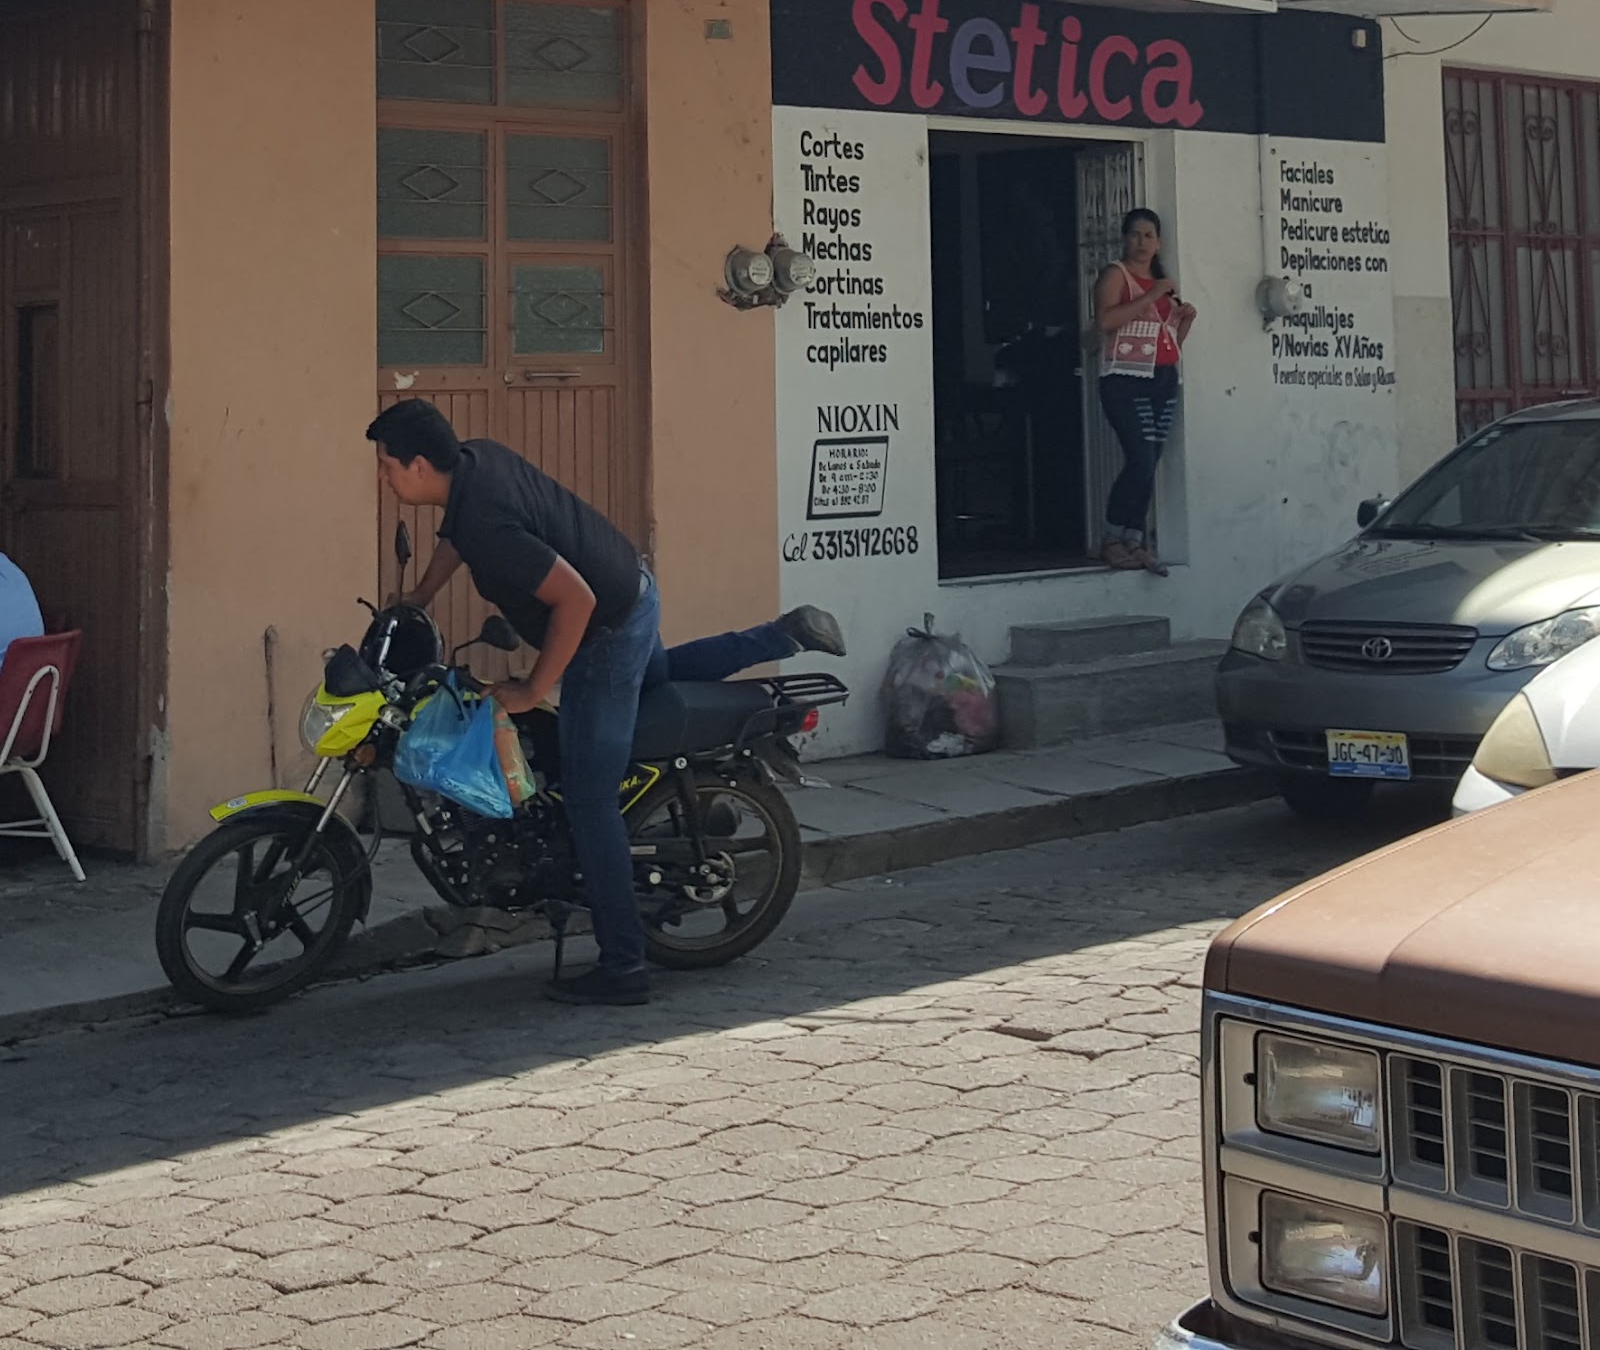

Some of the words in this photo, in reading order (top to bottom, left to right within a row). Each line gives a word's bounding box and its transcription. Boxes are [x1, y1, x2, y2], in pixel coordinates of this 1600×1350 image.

[800, 130, 864, 160] Cortes
[800, 163, 861, 193] Tintes
[1280, 160, 1334, 185] Faciales
[1280, 188, 1343, 213] Manicure
[803, 198, 862, 233] Rayos
[1280, 217, 1338, 243] Pedicure
[802, 232, 873, 261] Mechas
[1280, 246, 1362, 277] Depilaciones
[1365, 255, 1388, 272] con
[805, 268, 884, 295] ortinas
[804, 301, 924, 330] Tratamientos
[806, 337, 887, 372] capilares
[1272, 333, 1329, 359] P/Novias
[1335, 335, 1351, 358] XV
[1352, 335, 1383, 360] Años
[817, 404, 900, 433] NIOXIN
[783, 532, 808, 562] Cel
[812, 525, 919, 561] 3313192668
